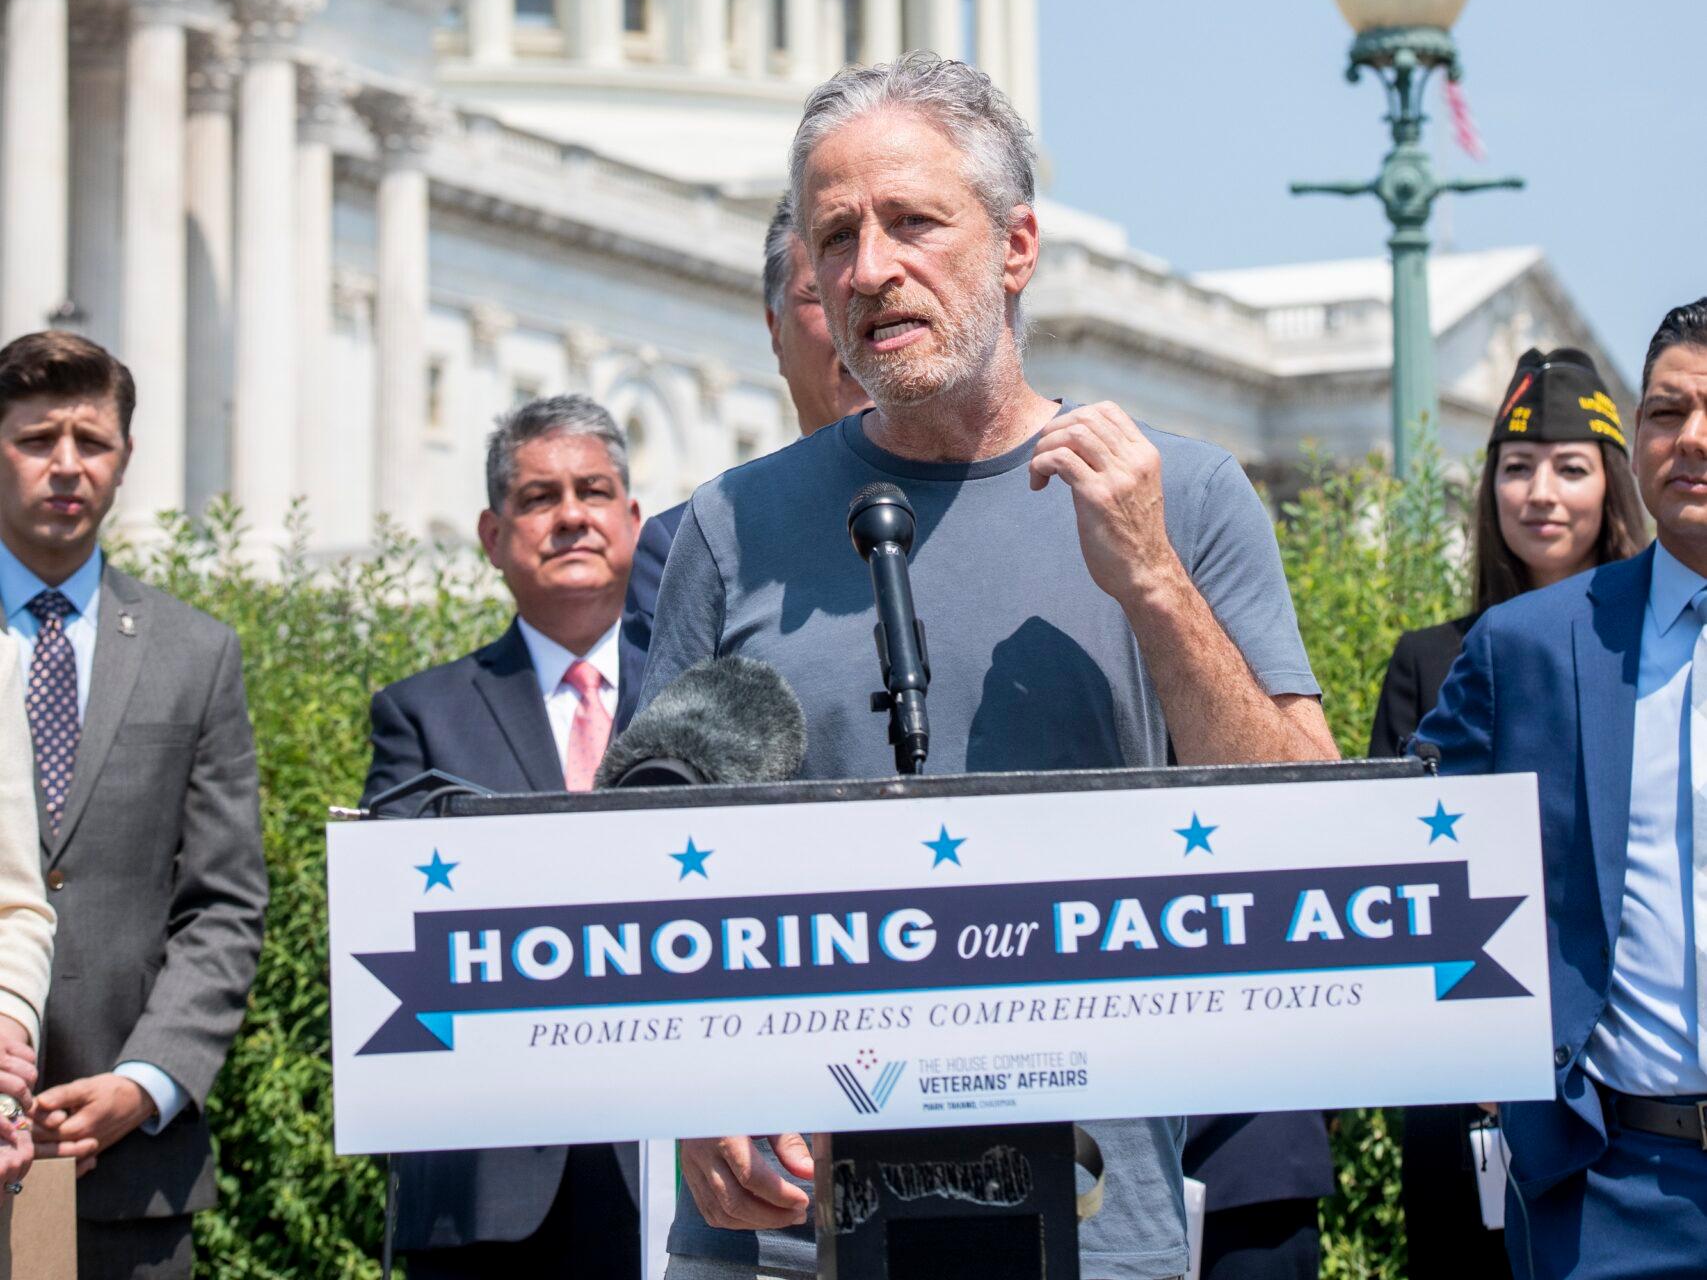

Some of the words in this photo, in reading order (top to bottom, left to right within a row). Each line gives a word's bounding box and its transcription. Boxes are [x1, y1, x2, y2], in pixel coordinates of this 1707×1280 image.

[448, 908, 938, 985] HONORING
[956, 921, 1040, 960] our
[1052, 892, 1255, 954] PACT
[1285, 883, 1441, 943] ACT
[529, 1017, 683, 1048] PROMISE
[702, 1014, 742, 1039] TO
[757, 1006, 913, 1036] ADDRESS
[928, 989, 1225, 1028] COMPREHENSIVE
[1241, 983, 1364, 1011] TOXICS
[918, 1058, 941, 1074] THE
[946, 1055, 988, 1072] HOUSE
[992, 1051, 1064, 1071] COMMITTEE
[1069, 1051, 1089, 1067] ON
[1017, 1069, 1088, 1090] AFFAIRS
